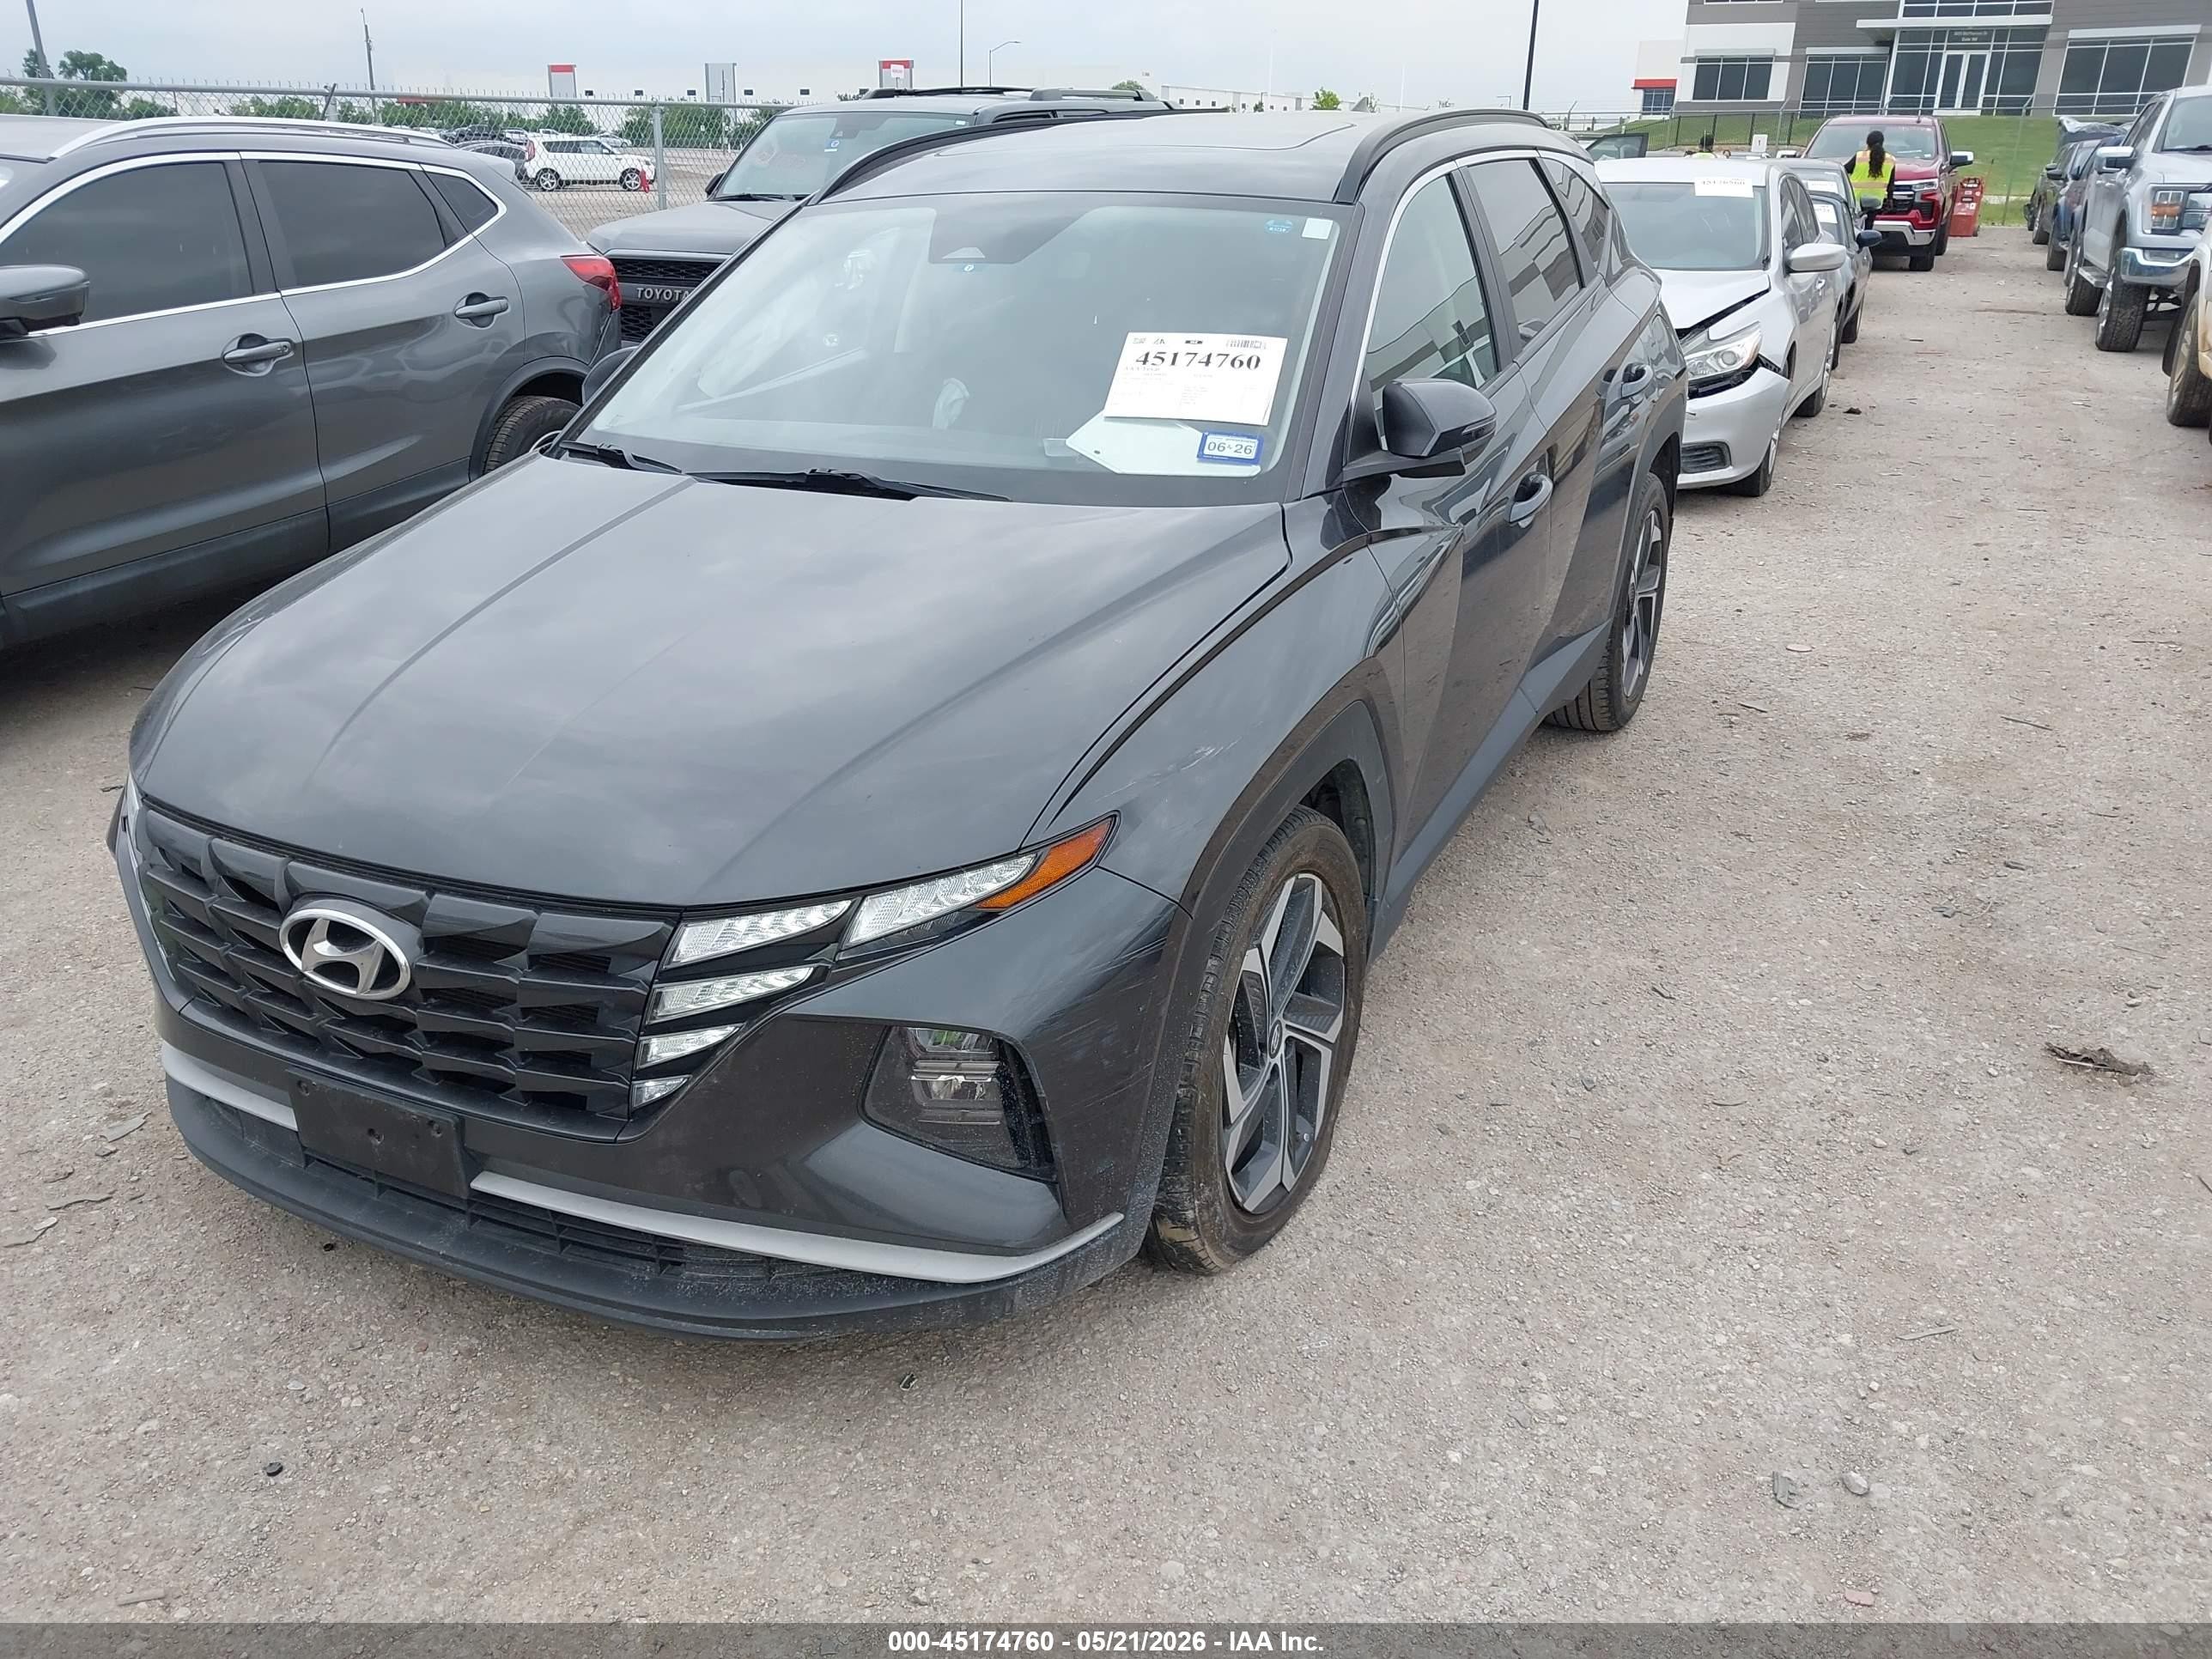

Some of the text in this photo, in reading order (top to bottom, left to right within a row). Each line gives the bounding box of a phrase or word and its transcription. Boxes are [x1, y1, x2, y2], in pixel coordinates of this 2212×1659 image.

[1135, 350, 1261, 370] 45174760
[1207, 441, 1254, 455] 06 26
